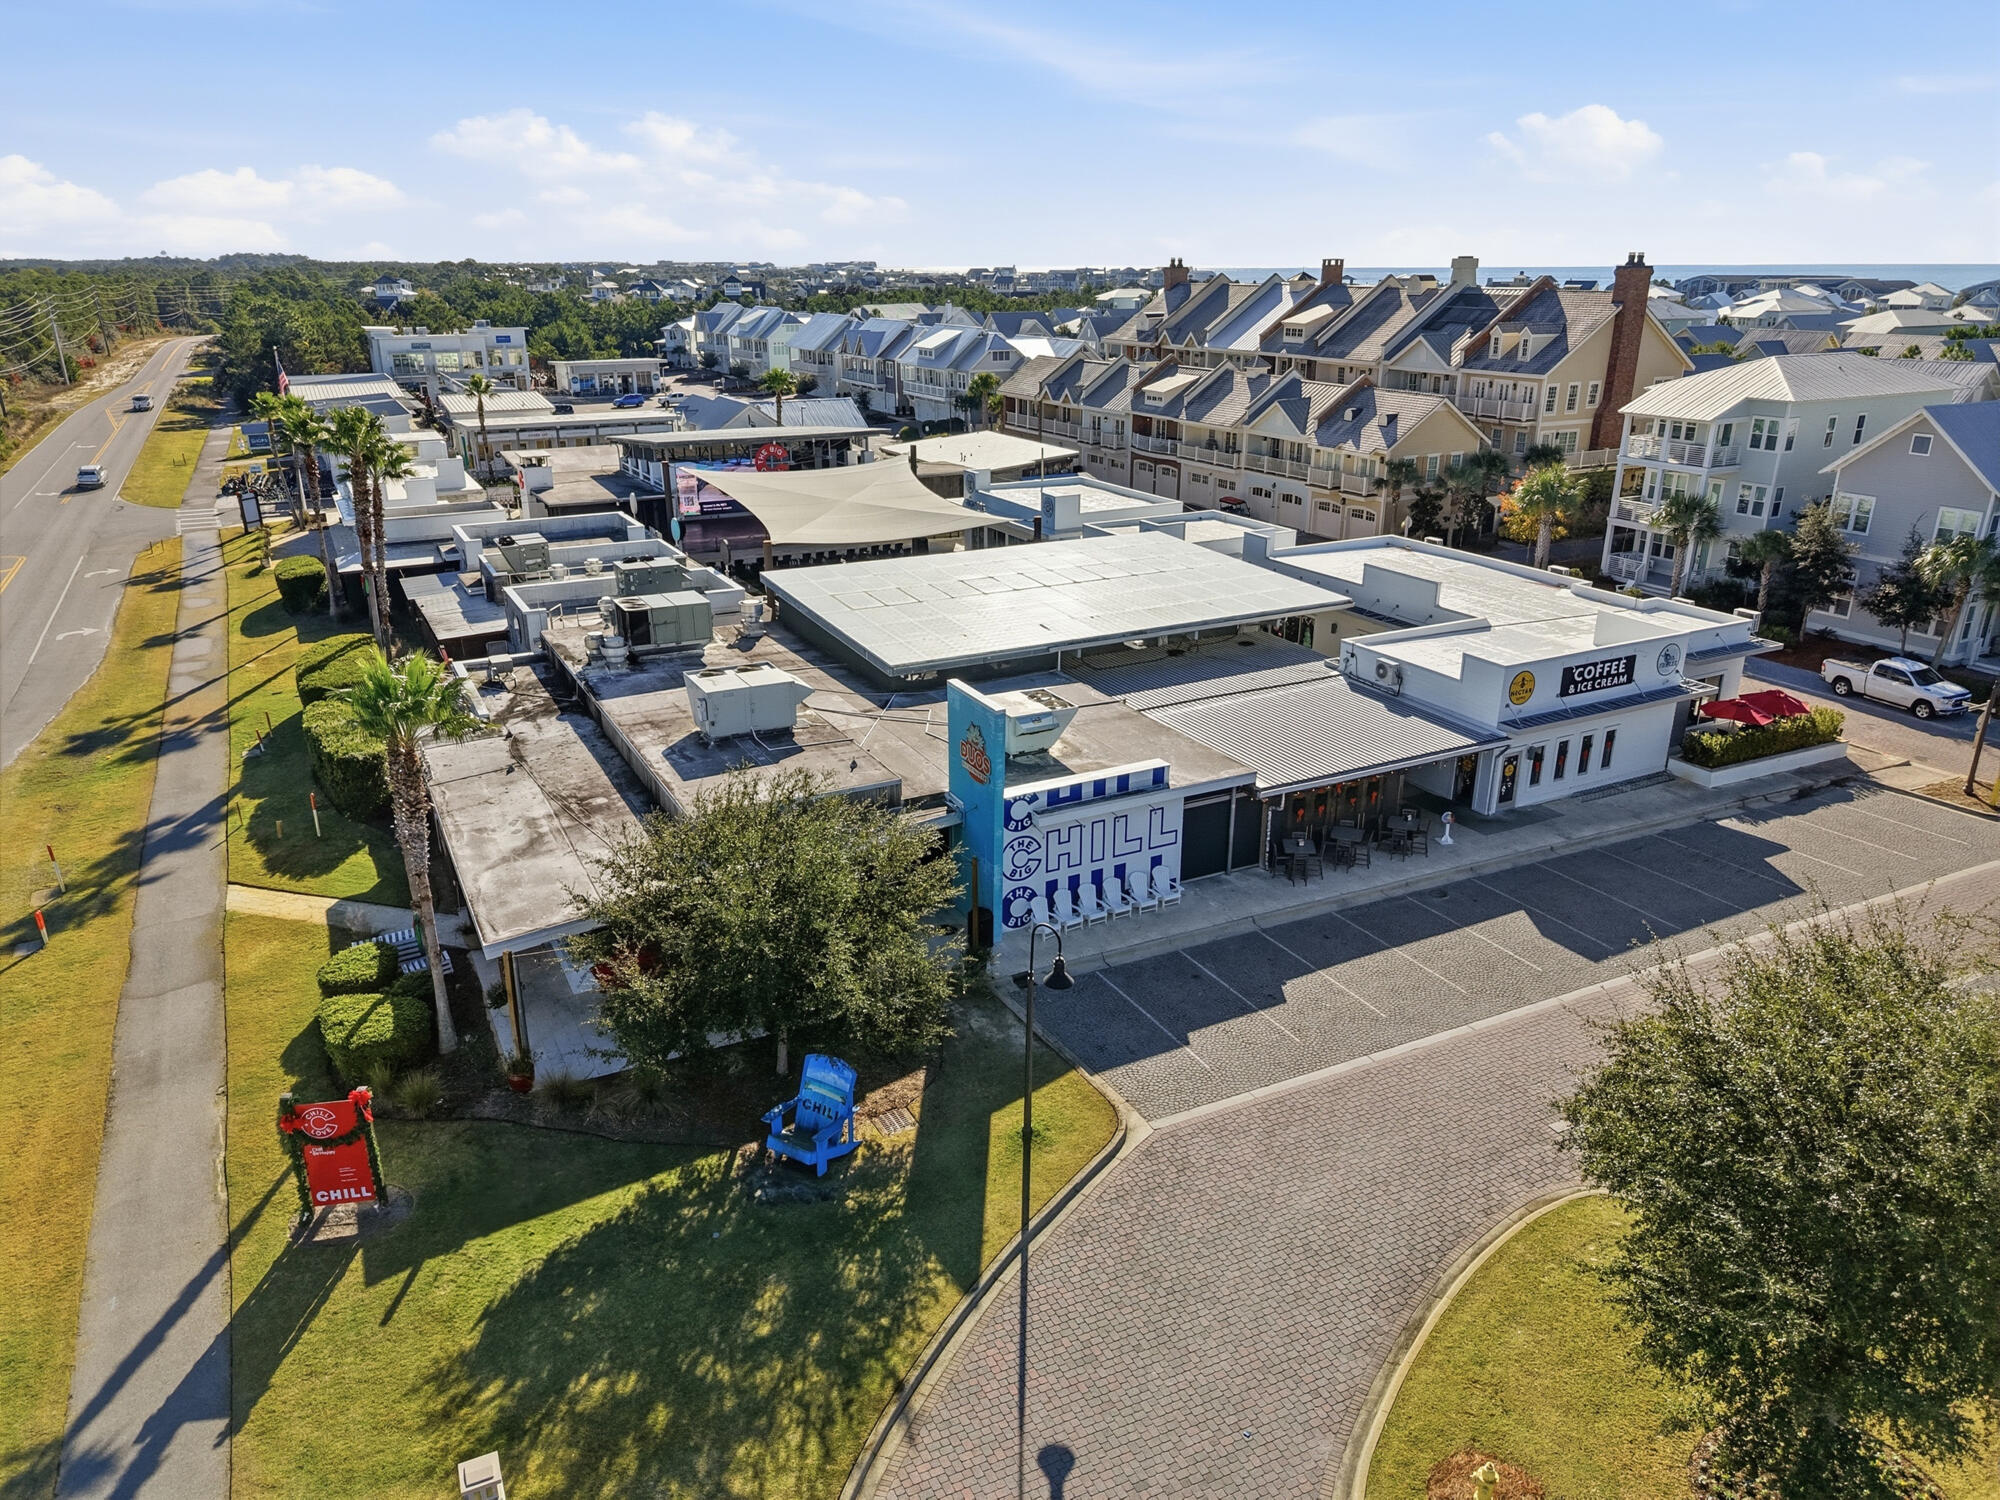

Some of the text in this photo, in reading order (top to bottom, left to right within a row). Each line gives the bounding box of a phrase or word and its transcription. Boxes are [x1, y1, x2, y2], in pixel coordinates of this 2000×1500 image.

[1574, 660, 1627, 681] COFFEE
[1568, 674, 1628, 694] & ICE CREAM
[961, 740, 991, 775] DUOS
[1008, 818, 1031, 830] BIG
[1009, 839, 1034, 852] THE
[1009, 865, 1031, 878] BIG
[1007, 888, 1032, 901] THE
[1008, 914, 1031, 927] BIG
[305, 1110, 330, 1120] CHILL
[311, 1126, 332, 1137] LOVE
[316, 1186, 372, 1202] CHILL
